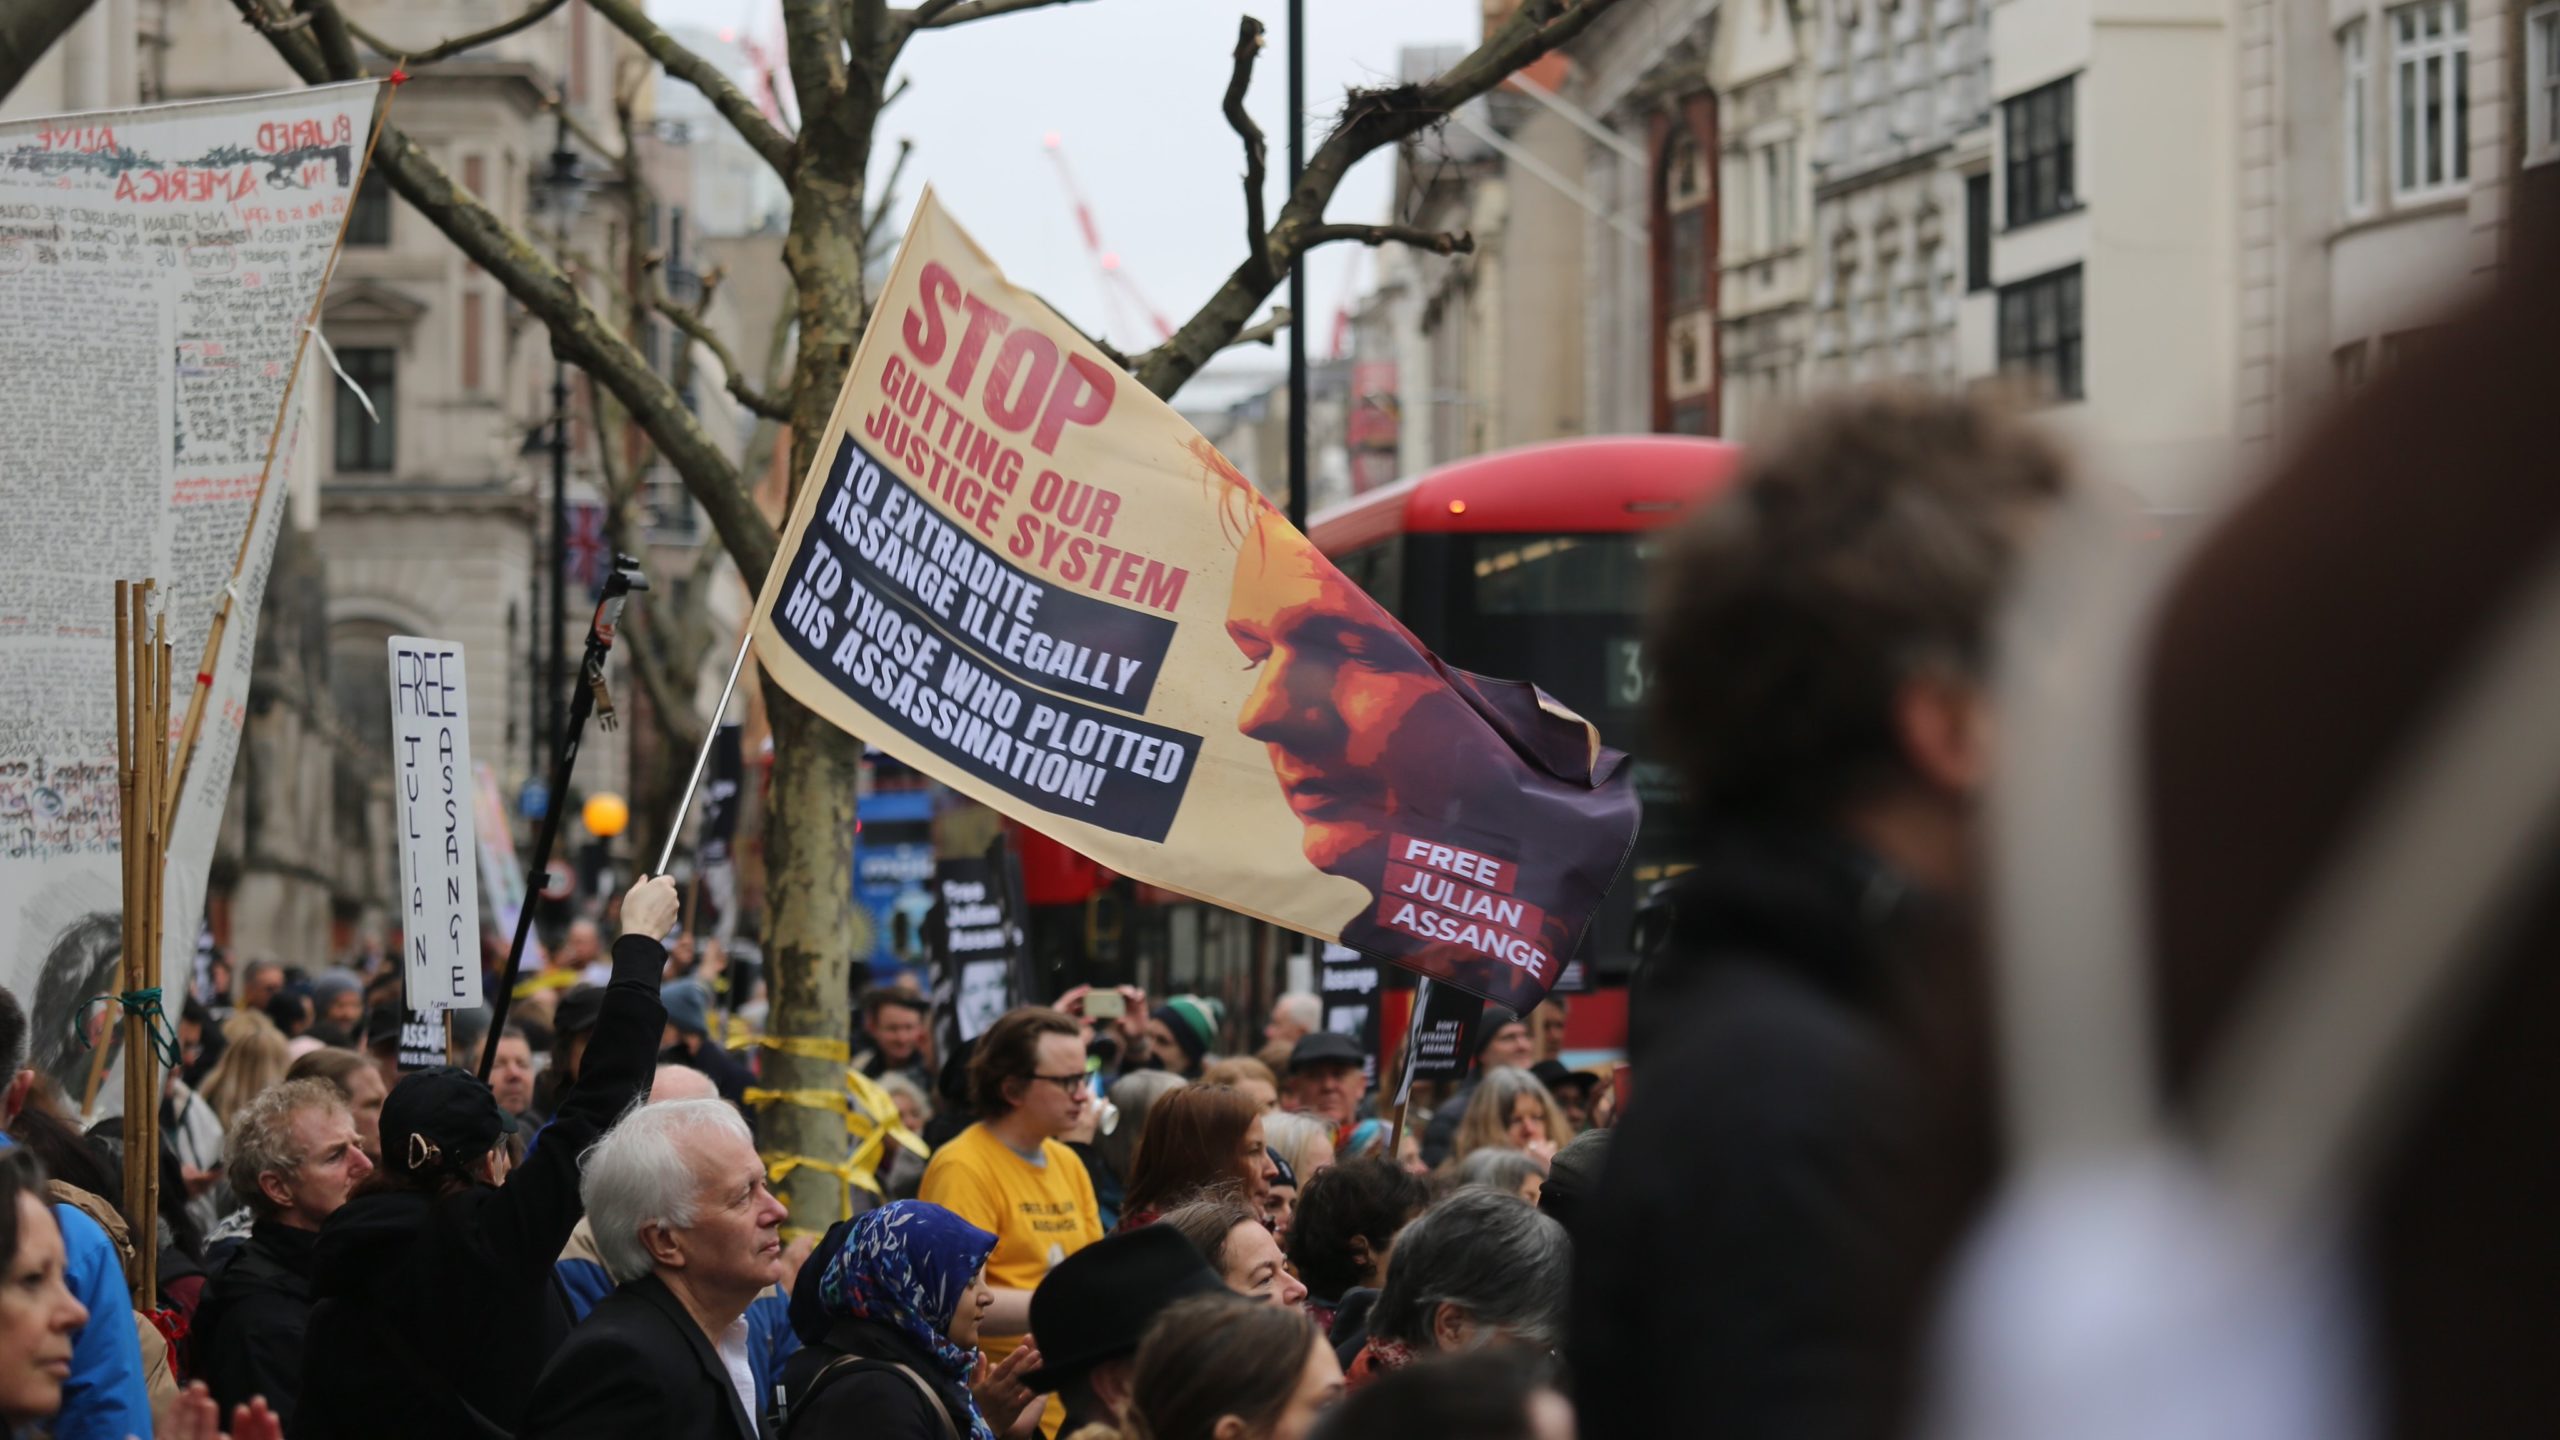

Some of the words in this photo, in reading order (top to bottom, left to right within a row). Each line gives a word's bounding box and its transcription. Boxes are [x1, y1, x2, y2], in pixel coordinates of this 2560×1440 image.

[881, 354, 1024, 496] GUTTING
[1030, 470, 1121, 538] OUR
[903, 259, 1116, 456] STOP
[826, 487, 959, 618] ASSANGE
[959, 593, 1142, 696] ILLEGALLY
[842, 447, 880, 505] TO
[880, 483, 1044, 625] EXTRADITE
[865, 403, 1005, 538] JUSTICE
[1008, 513, 1189, 613] SYSTEM
[398, 650, 458, 718] FREE
[784, 578, 835, 650] HIS
[832, 631, 1107, 806] ASSASSINATION!
[802, 539, 842, 600] TO
[843, 578, 942, 676] THOSE
[940, 652, 1021, 730] WHO
[1024, 703, 1185, 785] PLOTTED
[404, 735, 427, 967] JULIAN
[439, 727, 467, 997] ASSANGE
[1391, 903, 1547, 979] ASSANGE
[1400, 871, 1523, 928] JULIAN
[1404, 839, 1500, 887] FREE
